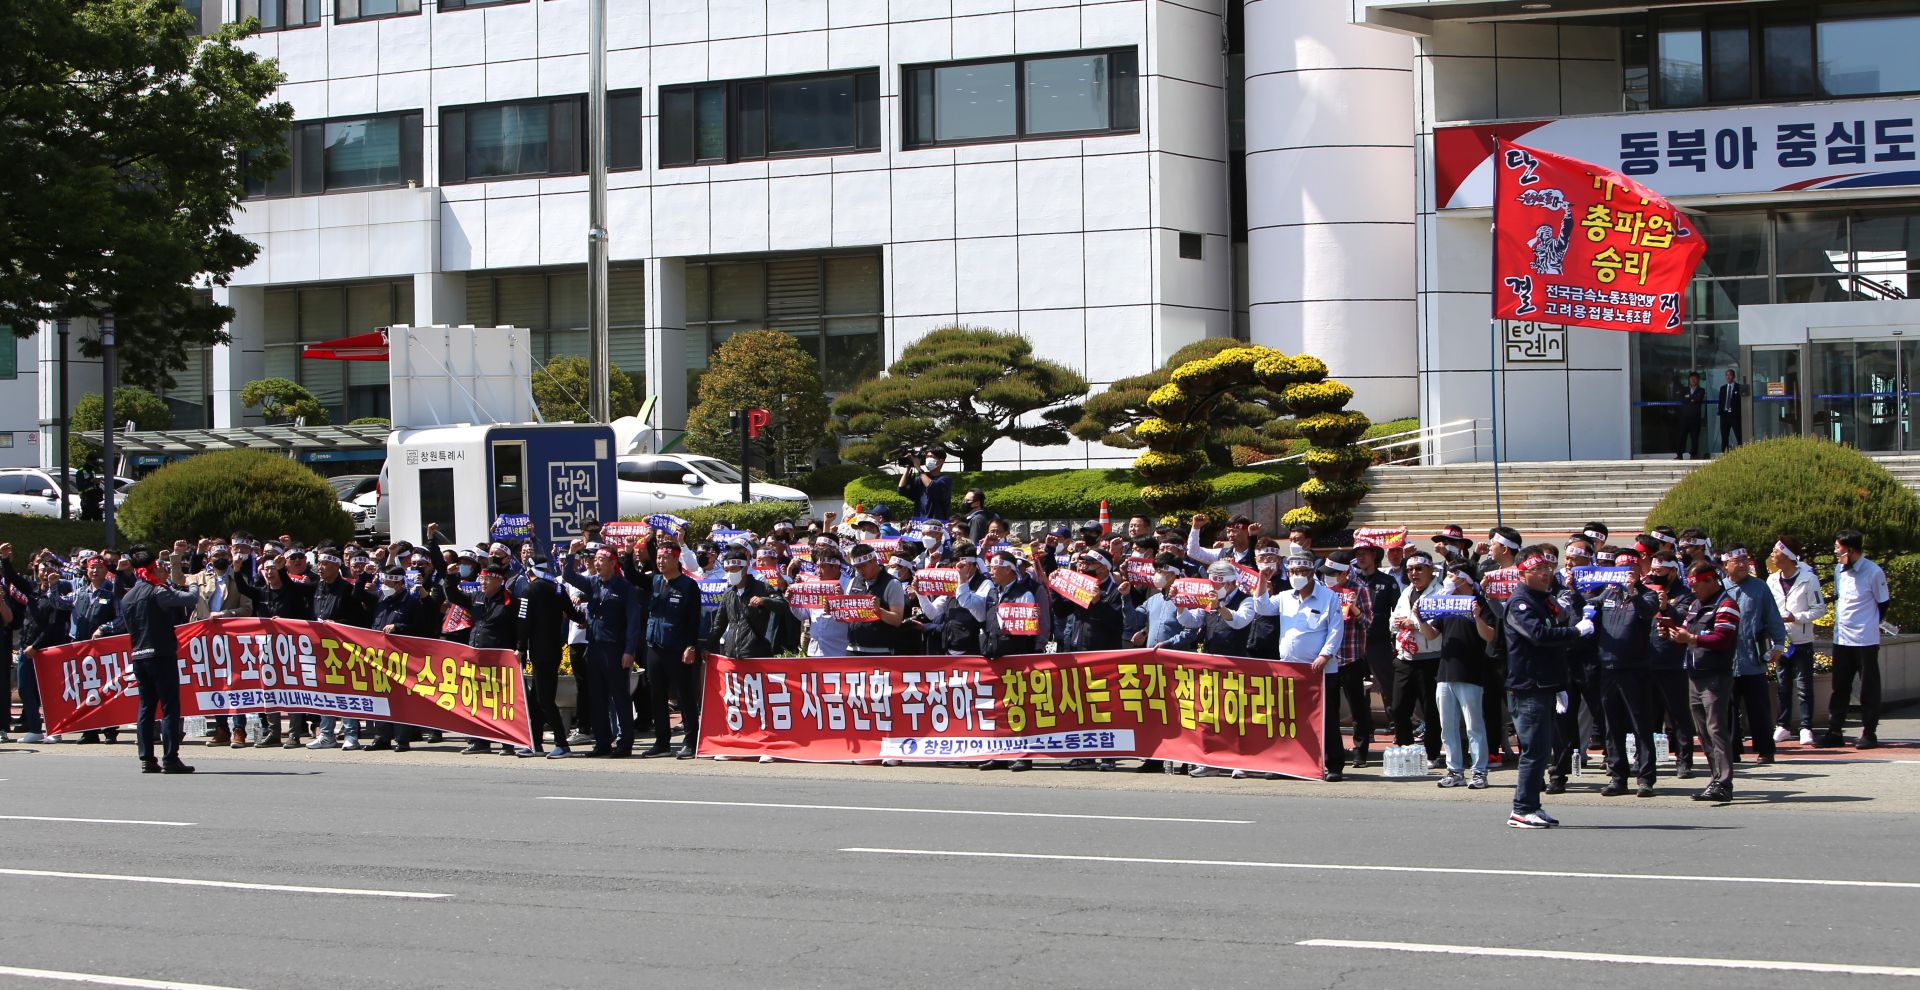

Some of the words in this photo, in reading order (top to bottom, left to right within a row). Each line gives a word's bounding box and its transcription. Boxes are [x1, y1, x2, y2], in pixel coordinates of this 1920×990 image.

[1620, 126, 1757, 175] 동북아
[1776, 118, 1916, 168] 중심도
[1581, 204, 1673, 248] 총파업
[1591, 246, 1651, 286] 승리
[749, 409, 771, 438] P
[421, 450, 465, 462] 창원특례시
[236, 633, 318, 688] 조정안을
[320, 638, 412, 696] 조건없이
[412, 655, 516, 721] 수용하라!!
[228, 691, 375, 713] 창원지역시내버스노동조합
[723, 671, 793, 732] 상여금
[800, 669, 894, 731] 시급전환
[901, 668, 997, 733] 주장하는
[1001, 666, 1113, 732] 창원시는
[1117, 663, 1168, 725] 즉각
[1174, 664, 1297, 739] 철회하라!!
